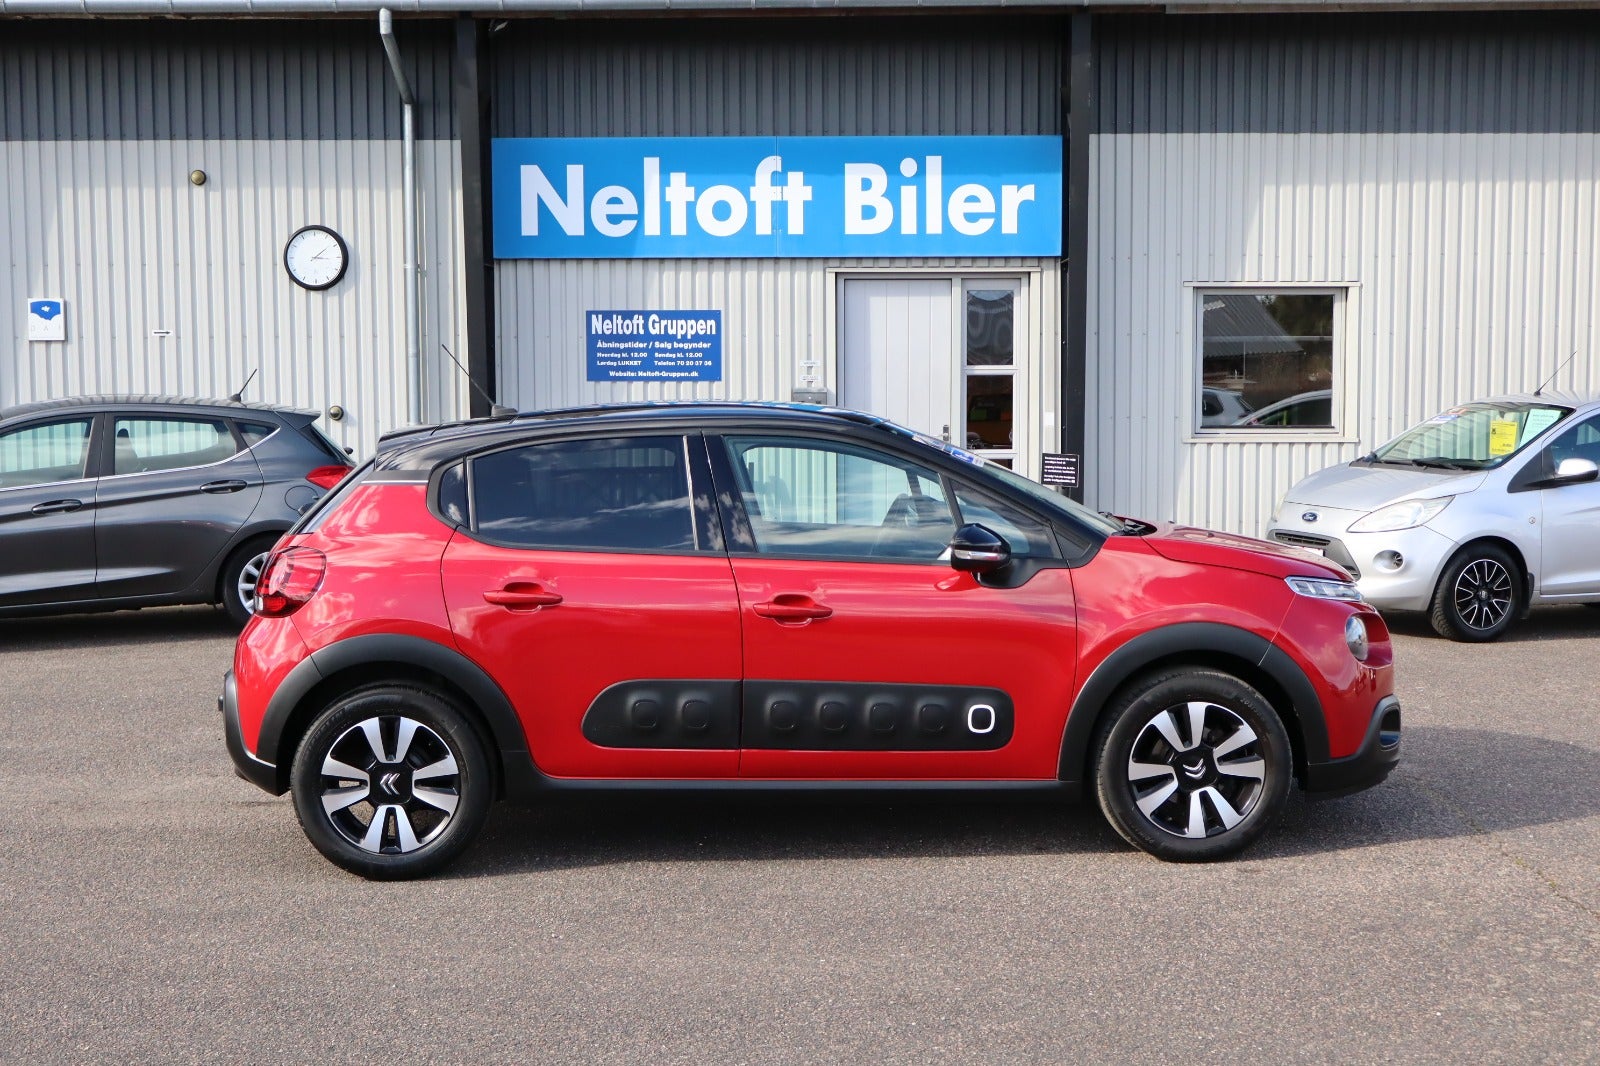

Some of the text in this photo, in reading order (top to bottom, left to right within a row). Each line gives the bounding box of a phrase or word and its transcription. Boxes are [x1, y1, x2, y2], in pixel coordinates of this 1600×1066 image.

[520, 155, 1035, 238] Neltoft Biler
[591, 313, 716, 339] Neltoft Gruppen
[597, 340, 712, 350] Åbningstider / Salg begynder
[638, 370, 699, 378] Neltoft-Gruppen.dk
